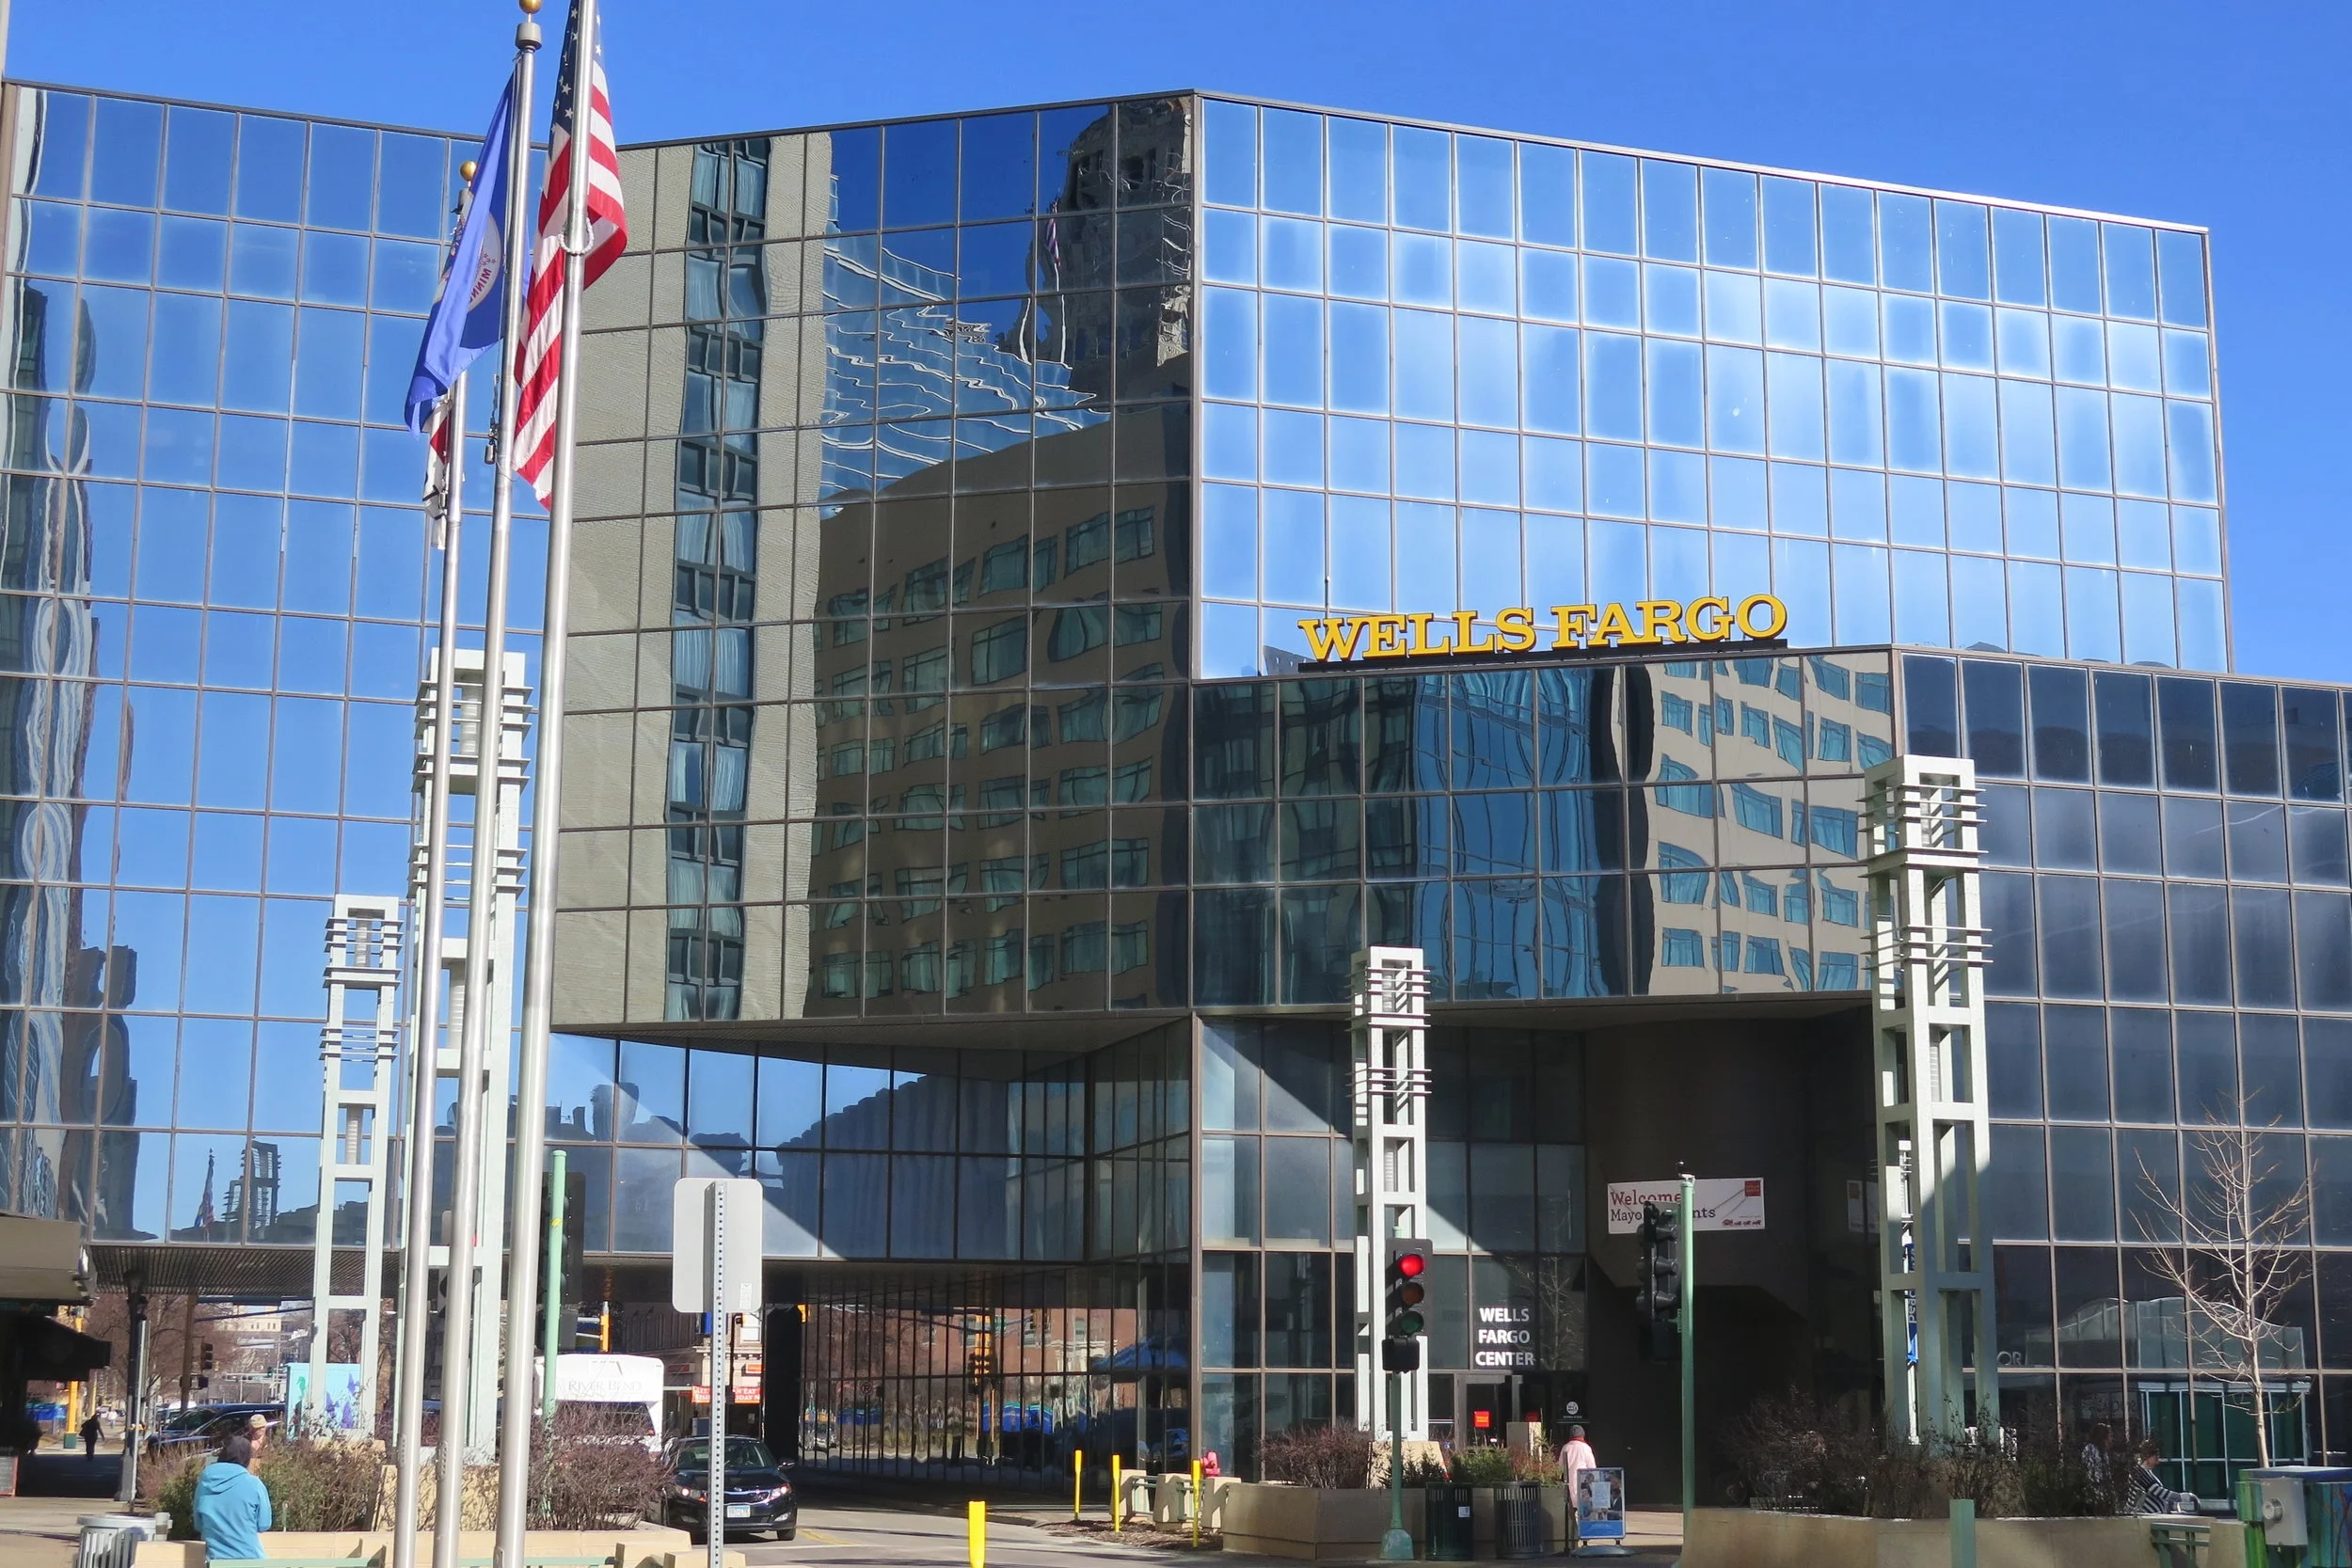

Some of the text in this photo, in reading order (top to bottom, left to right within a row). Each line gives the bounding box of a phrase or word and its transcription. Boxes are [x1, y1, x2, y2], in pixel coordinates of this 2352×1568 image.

[1298, 594, 1788, 662] WELLS FARGO
[1610, 1208, 1642, 1224] Mayo
[1479, 1307, 1530, 1323] WELLS
[1478, 1329, 1531, 1344] FARGO
[1475, 1351, 1534, 1366] CENTER
[568, 1380, 643, 1391] RIVER BEND
